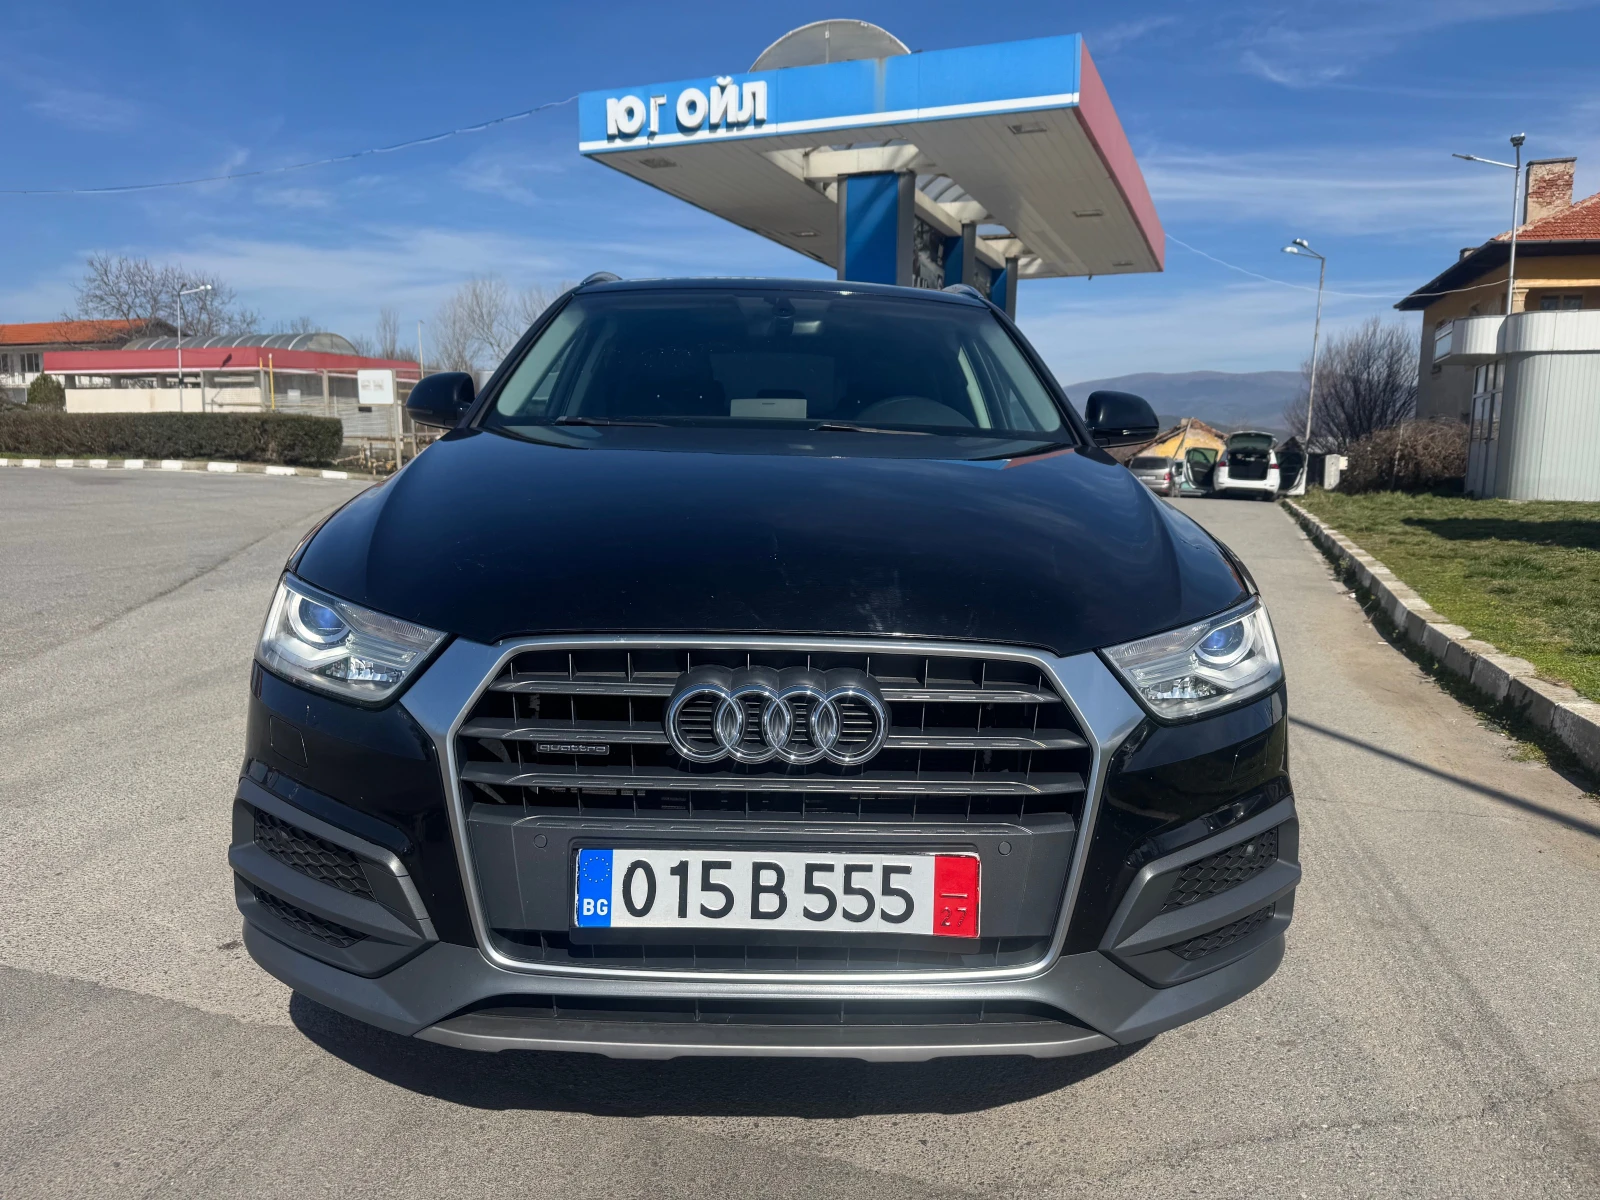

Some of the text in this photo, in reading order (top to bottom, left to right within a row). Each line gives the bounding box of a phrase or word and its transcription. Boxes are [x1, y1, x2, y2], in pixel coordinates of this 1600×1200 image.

[606, 76, 767, 135] ЮГ ОЙЛ
[539, 744, 606, 752] quattro
[582, 898, 609, 916] BG
[941, 906, 967, 927] 27
